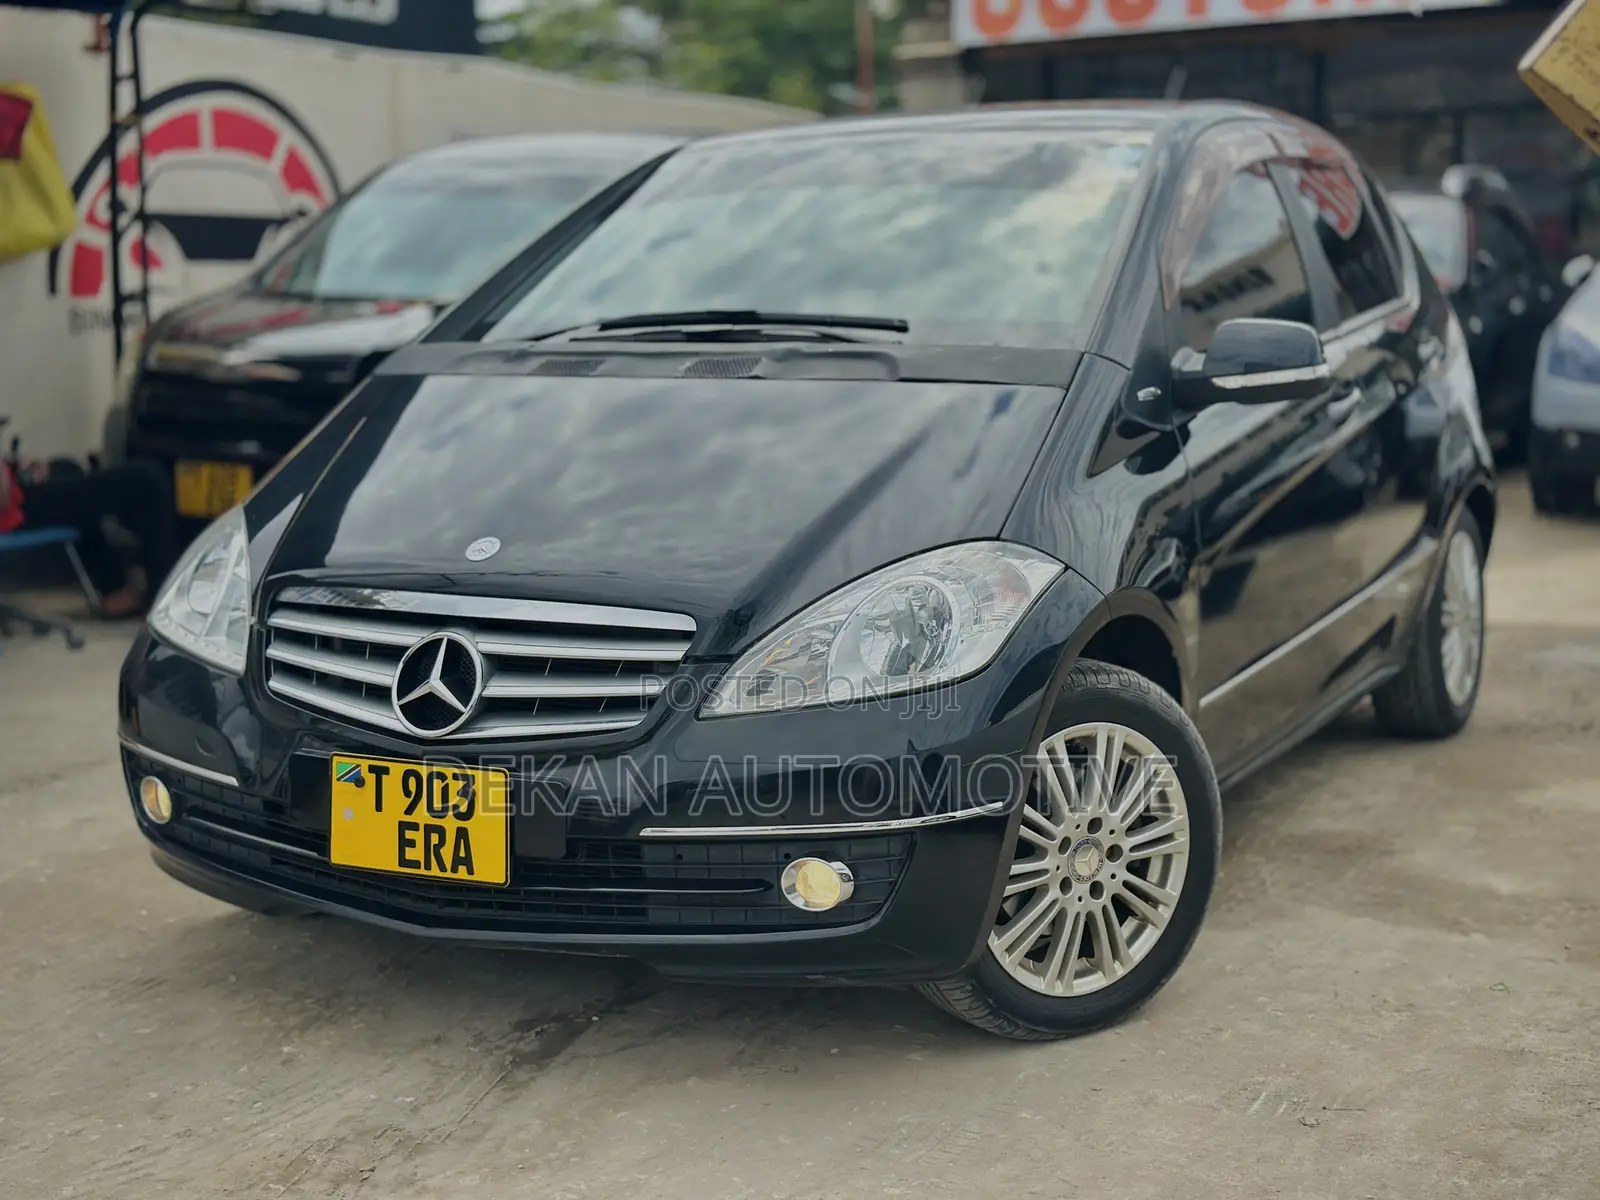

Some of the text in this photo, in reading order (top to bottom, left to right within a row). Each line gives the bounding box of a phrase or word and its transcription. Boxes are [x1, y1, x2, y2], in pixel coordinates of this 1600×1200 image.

[367, 763, 477, 822] T 903
[397, 820, 475, 876] ERA
